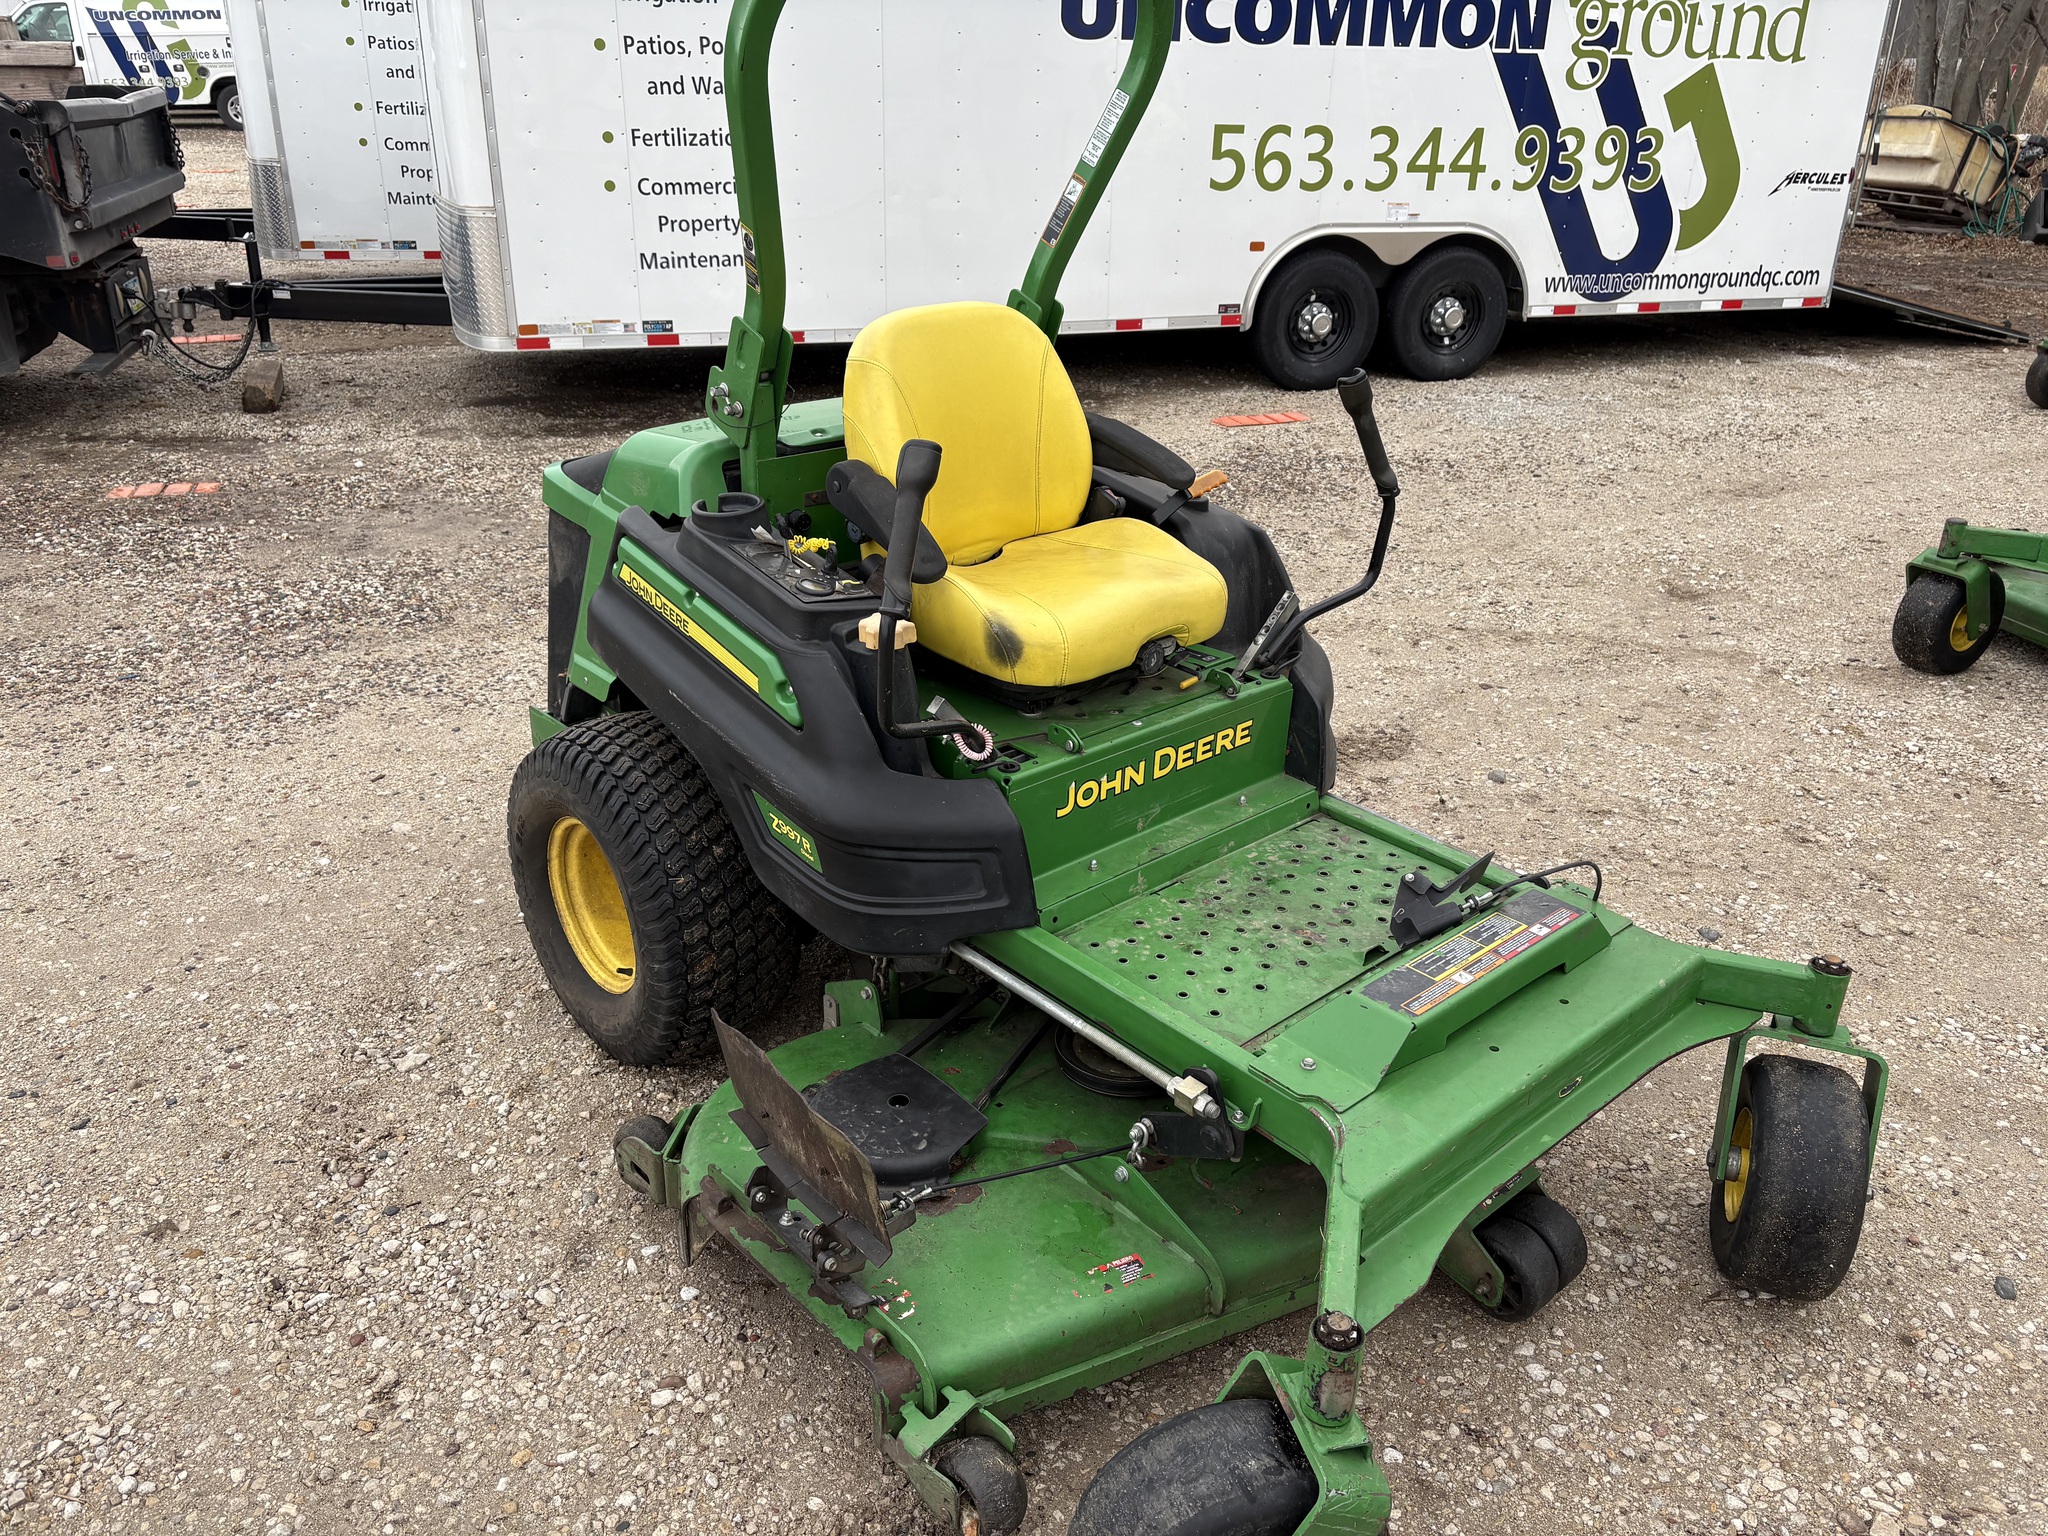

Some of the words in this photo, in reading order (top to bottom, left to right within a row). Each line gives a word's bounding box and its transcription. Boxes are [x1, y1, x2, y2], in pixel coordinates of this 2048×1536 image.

[94, 10, 221, 20] UNCOMMON
[126, 50, 171, 62] Irrigation
[174, 49, 210, 60] Service
[212, 49, 219, 59] &
[623, 34, 692, 58] Patios,
[699, 36, 724, 55] Po
[1565, 0, 1811, 91] ground
[386, 64, 415, 79] and
[647, 75, 685, 95] and
[691, 76, 724, 95] Wa
[1209, 124, 1664, 196] 563.344.9393
[1767, 169, 1848, 197] HERCULES
[658, 215, 741, 237] Property
[639, 251, 744, 270] Maintenan
[1544, 265, 1820, 294] www.uncommongroundqc.com
[625, 571, 653, 603] JOHN
[654, 594, 690, 635] DEERE
[1056, 758, 1146, 819] JOHN
[1152, 718, 1254, 781] DEERE
